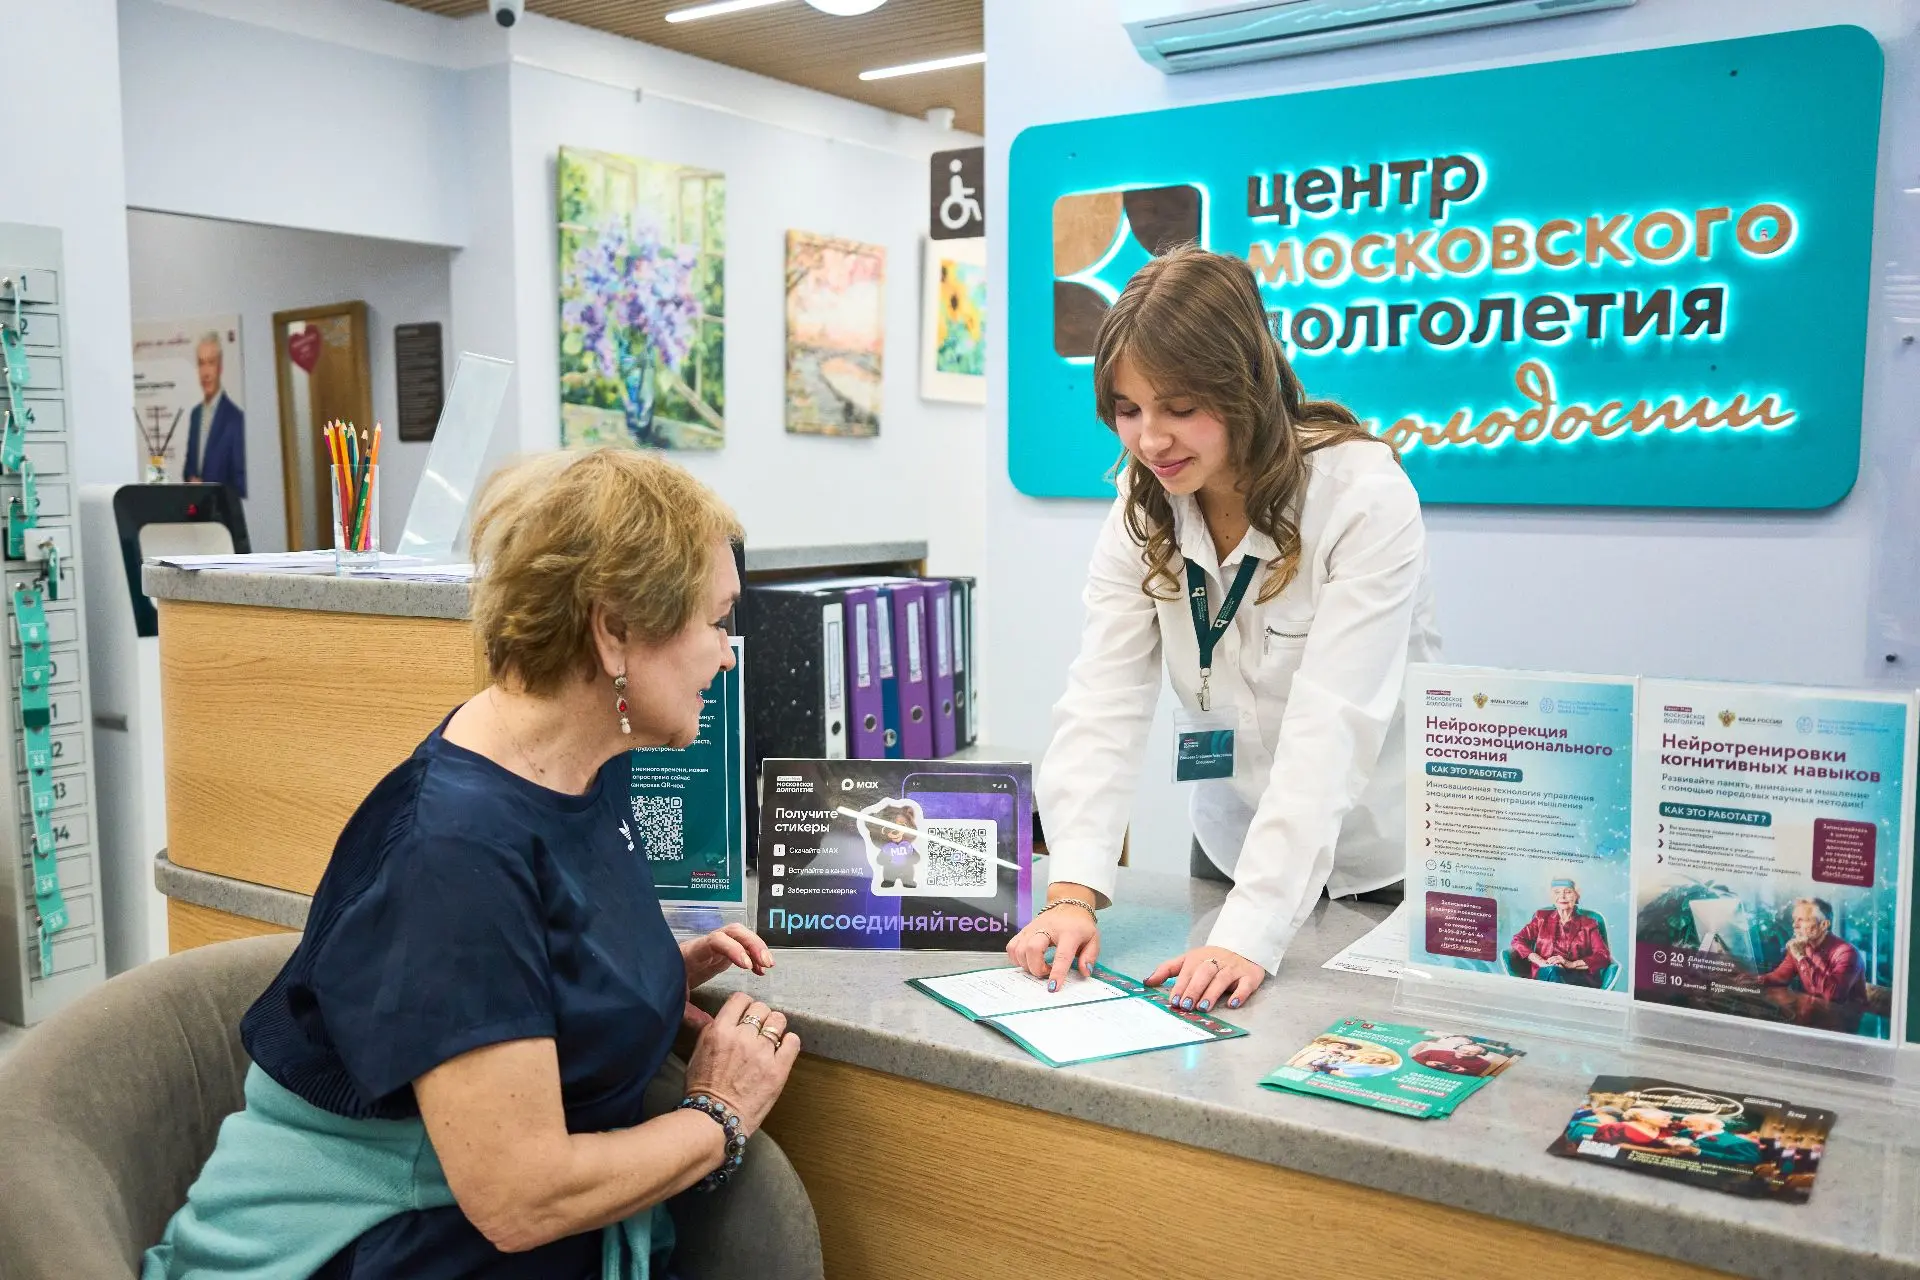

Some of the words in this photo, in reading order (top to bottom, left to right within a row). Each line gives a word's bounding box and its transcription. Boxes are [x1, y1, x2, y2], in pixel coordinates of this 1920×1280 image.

[1247, 154, 1479, 225] центр
[1248, 203, 1793, 283] московского
[20, 275, 28, 292] 1
[20, 317, 30, 335] 2
[1362, 361, 1797, 452] олодости
[1663, 712, 1705, 720] МОСКОВСКОЕ
[1426, 716, 1567, 739] Нейрокоррекция
[1426, 734, 1613, 756] психоэмоционального
[1662, 733, 1847, 763] Нейротренировки
[1426, 747, 1507, 762] состояния
[1431, 766, 1448, 774] КАК
[1450, 767, 1467, 775] ЭТО
[1469, 769, 1517, 780] РАБОТАЕТ?
[1661, 753, 1788, 775] когнитивных
[1793, 767, 1881, 783] навыков
[53, 782, 67, 799] 13
[1426, 780, 1491, 793] Инновационная
[1493, 787, 1541, 797] технология
[1543, 791, 1594, 802] управления
[1662, 773, 1715, 786] Развивайте
[1717, 779, 1753, 790] память,
[1755, 782, 1804, 793] внимание
[1814, 788, 1870, 799] мышление
[1426, 790, 1467, 800] эмоциями
[1476, 795, 1536, 807] концентрации
[1537, 800, 1583, 810] мышления
[1669, 785, 1714, 795] помощью
[1716, 790, 1770, 801] передовых
[1772, 794, 1814, 805] научных
[1817, 798, 1864, 809] методик!
[775, 807, 839, 821] Получите
[1664, 805, 1684, 815] КАК
[1687, 807, 1706, 818] ЭТО
[1708, 810, 1758, 823] РАБОТАЕТ
[1760, 814, 1766, 823] ?
[53, 825, 69, 842] 14
[775, 822, 830, 833] стикеры
[789, 846, 821, 854] Скачайте
[788, 867, 827, 875] Вступайте
[1440, 860, 1451, 869] 45
[788, 887, 820, 895] Заберите
[1441, 878, 1450, 887] 10
[769, 908, 1008, 934] Присоединяйтесь!
[1670, 952, 1684, 962] 20
[1688, 956, 1735, 968] Длительность
[1692, 964, 1732, 972] тренировки
[1670, 976, 1682, 986] 10
